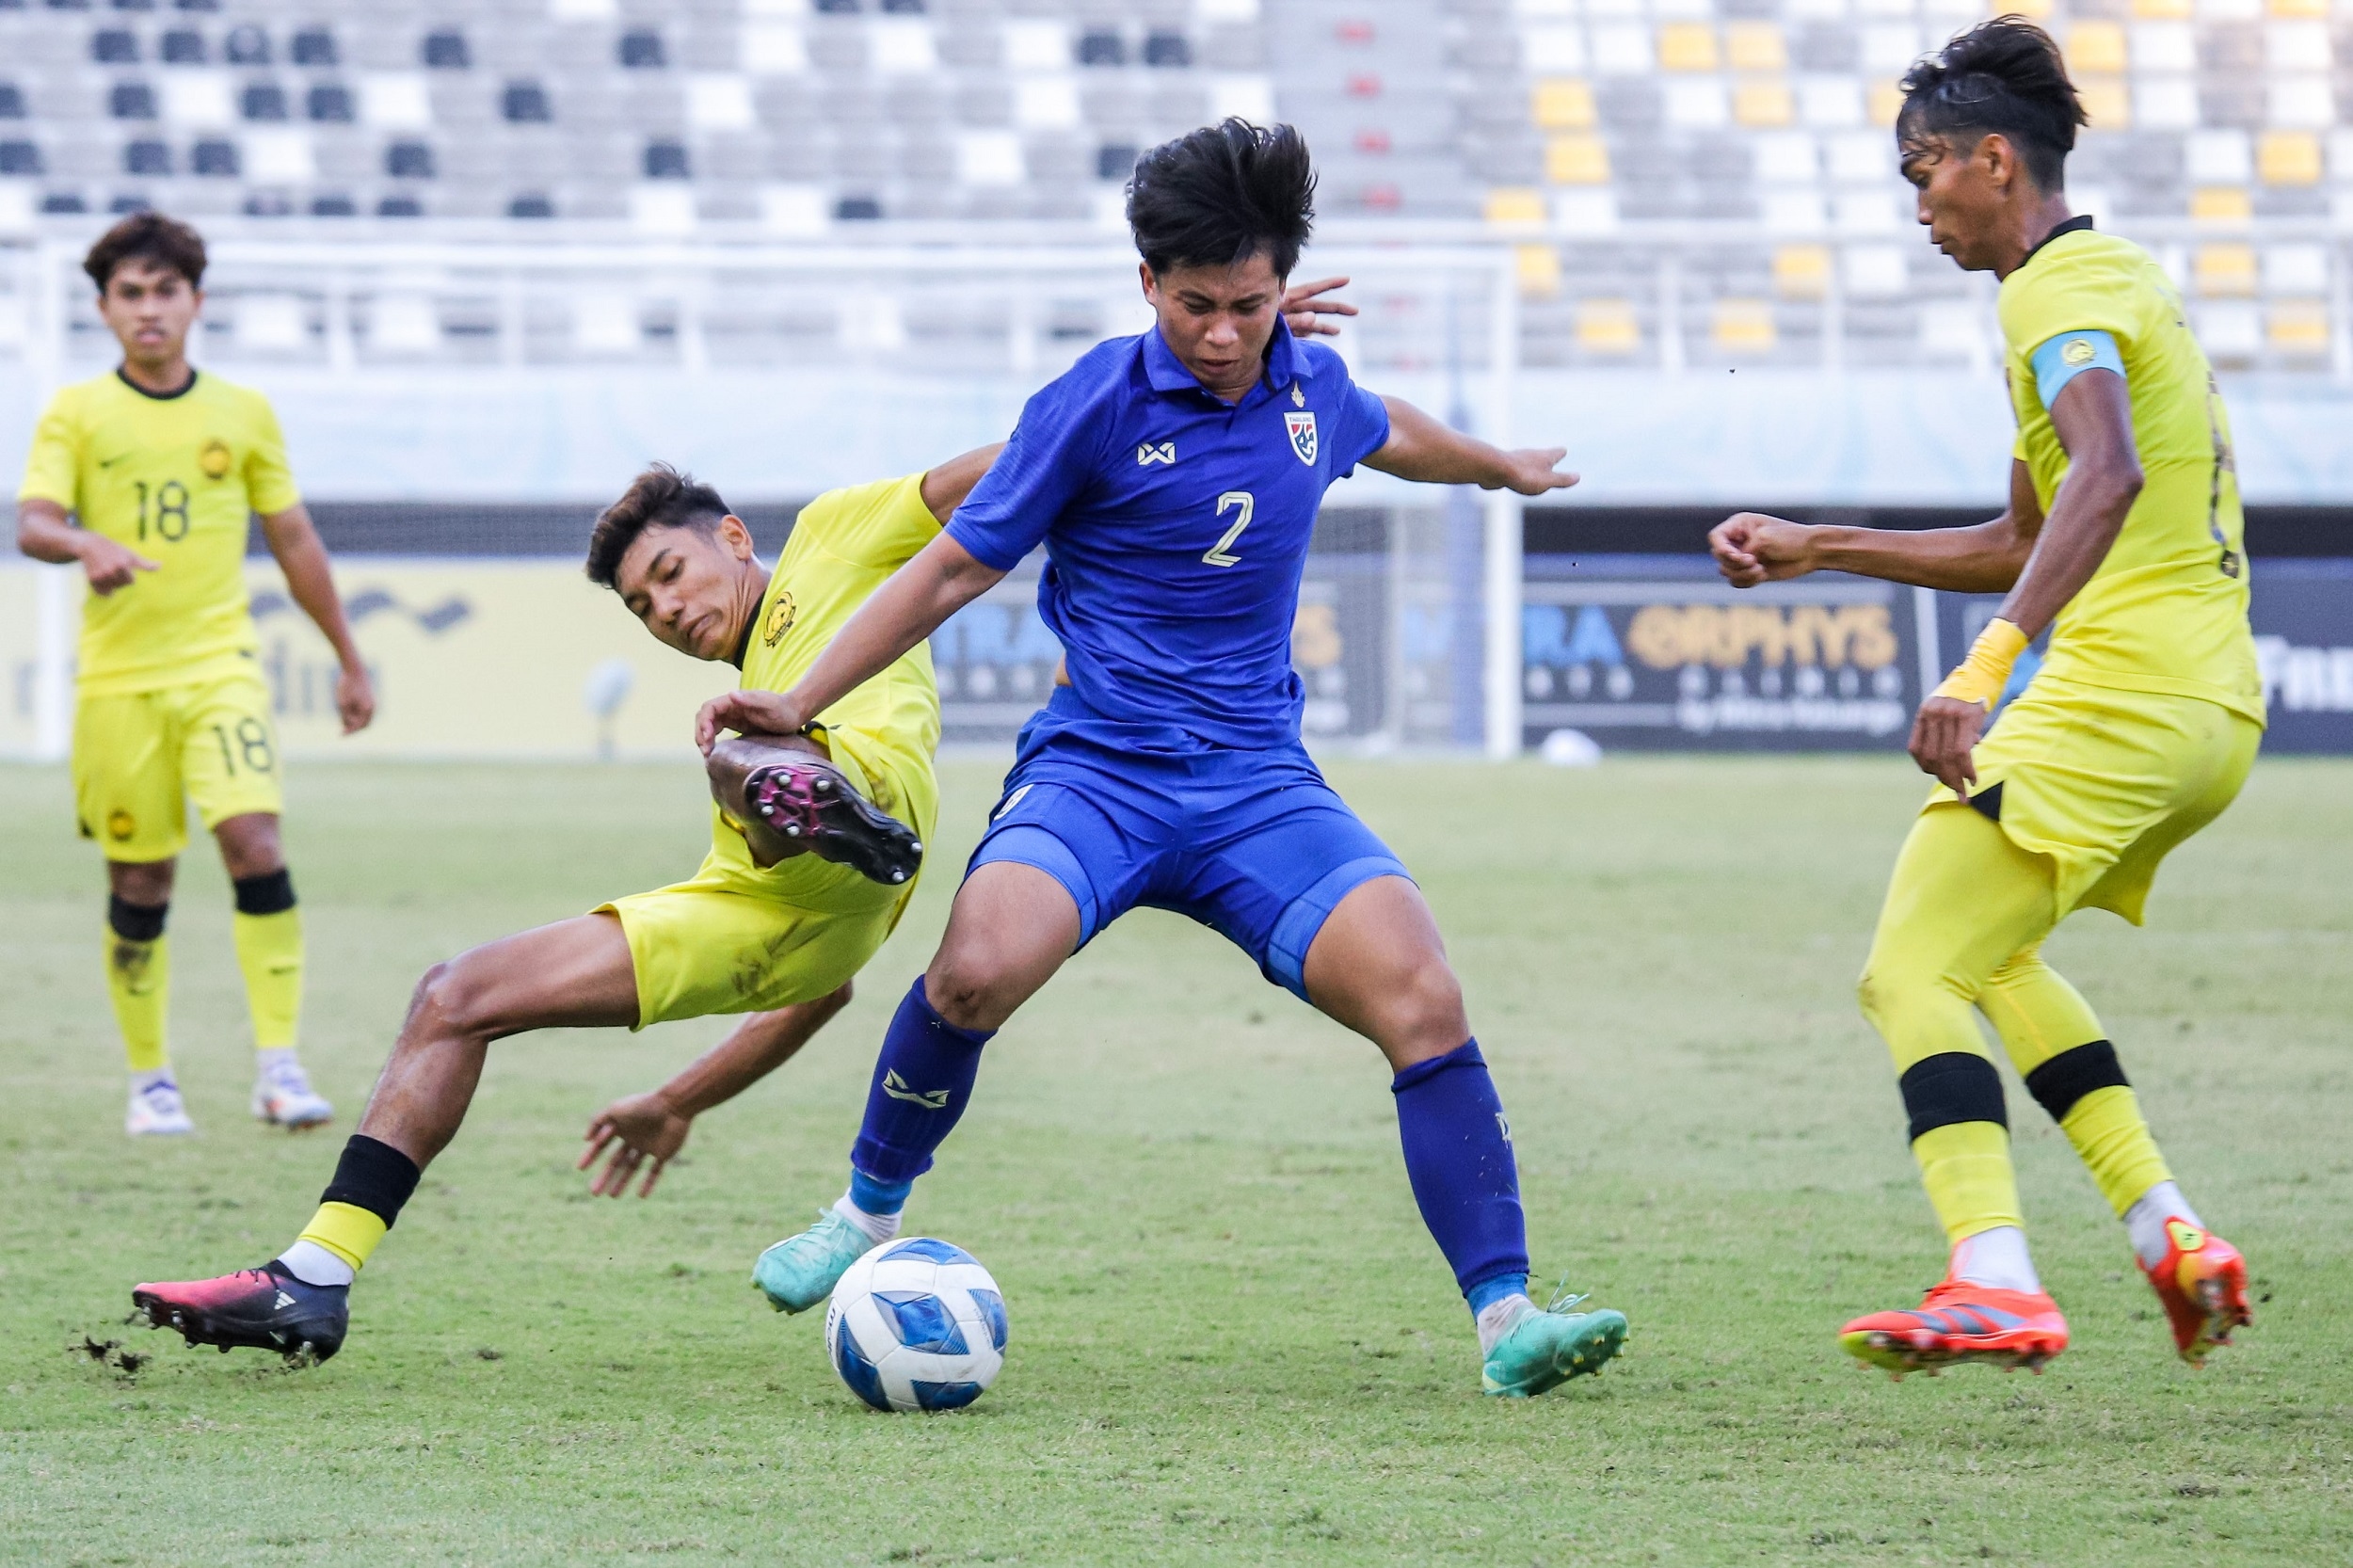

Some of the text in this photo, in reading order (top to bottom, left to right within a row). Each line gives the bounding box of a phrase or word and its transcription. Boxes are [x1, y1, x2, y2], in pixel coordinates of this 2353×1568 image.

[136, 480, 190, 541] 18
[1202, 490, 1255, 568] 2
[211, 717, 273, 776] 18
